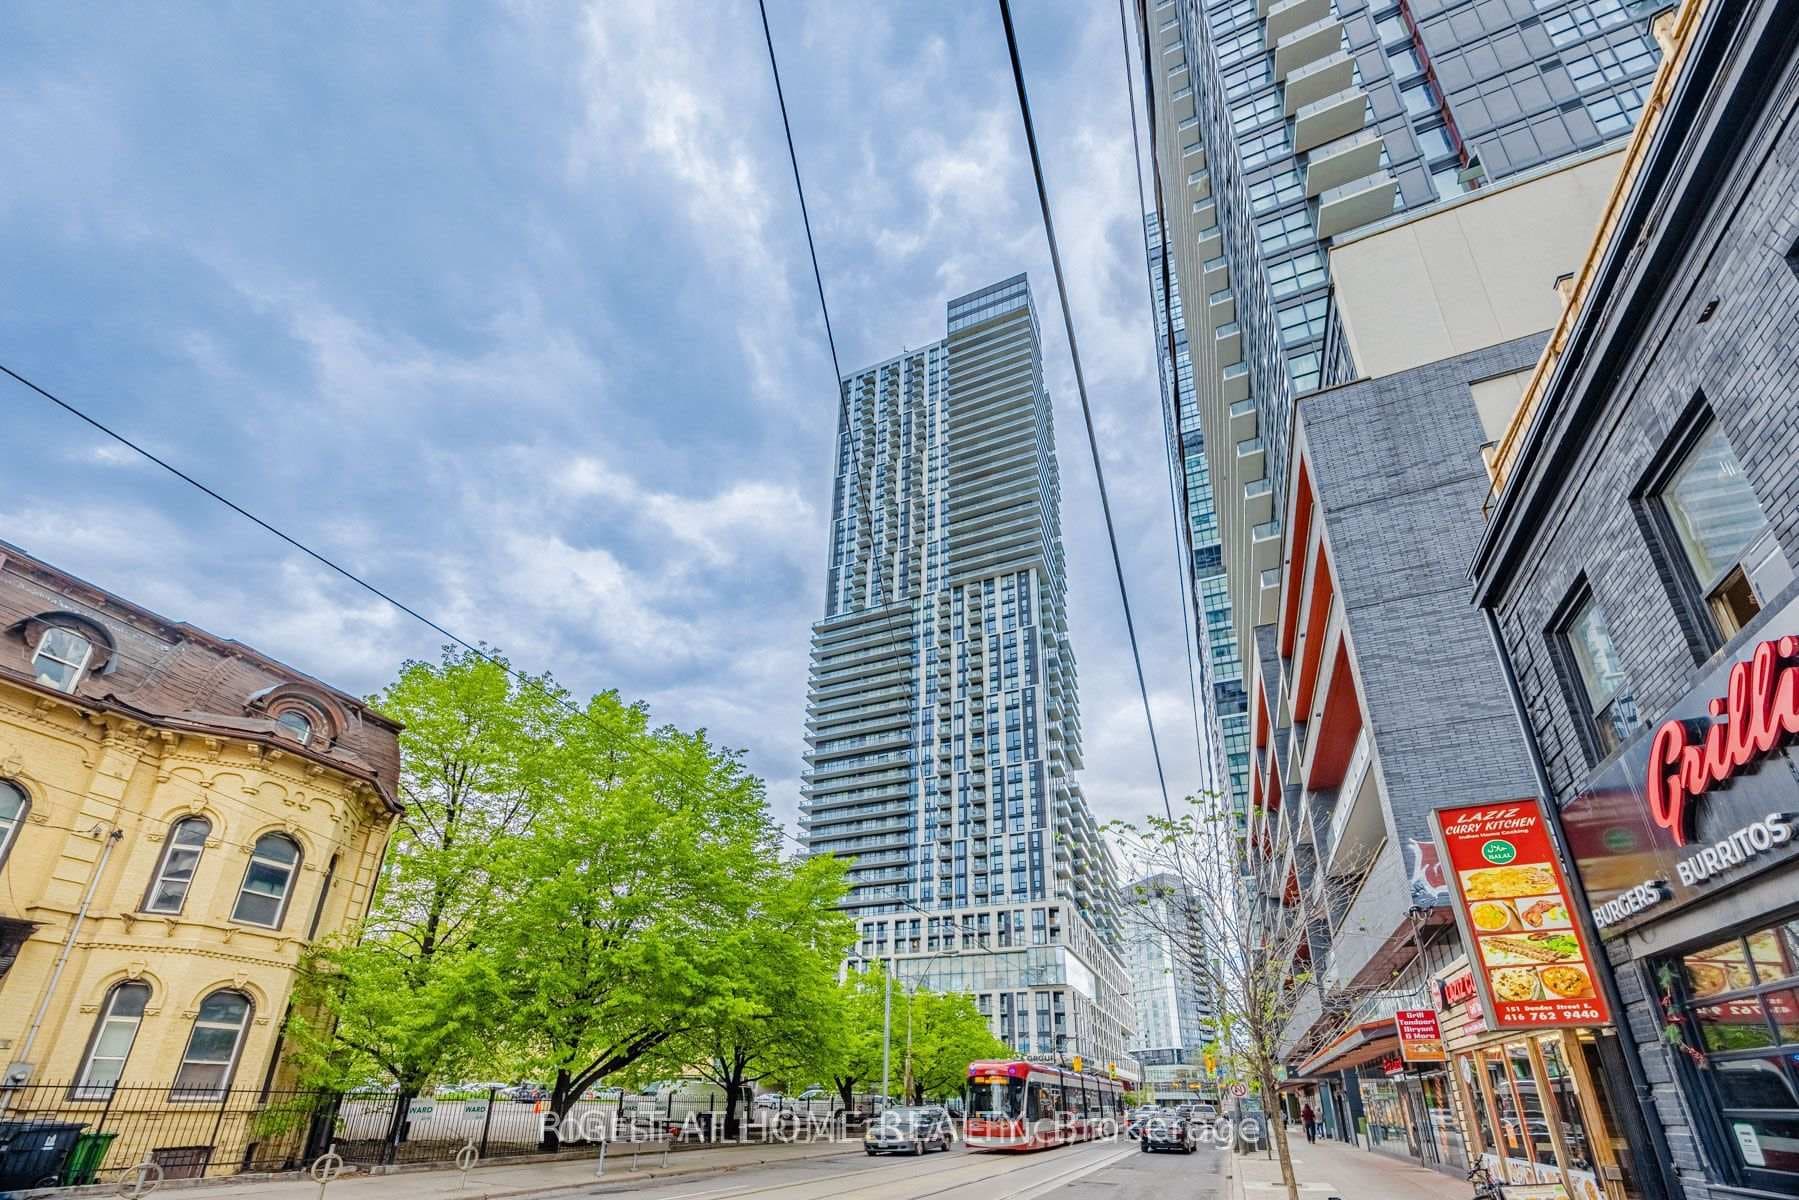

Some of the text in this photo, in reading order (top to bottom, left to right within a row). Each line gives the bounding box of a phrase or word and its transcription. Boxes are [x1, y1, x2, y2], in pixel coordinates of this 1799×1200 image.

[1457, 807, 1521, 823] LAZIZ
[1445, 816, 1536, 836] CURRY KITCHEN
[1488, 852, 1512, 860] HALAL
[1592, 812, 1790, 930] BURGERS BURRITOS
[1524, 1004, 1553, 1012] Dundas
[1406, 1011, 1425, 1019] Grill
[1503, 1009, 1599, 1021] 416 762 9440
